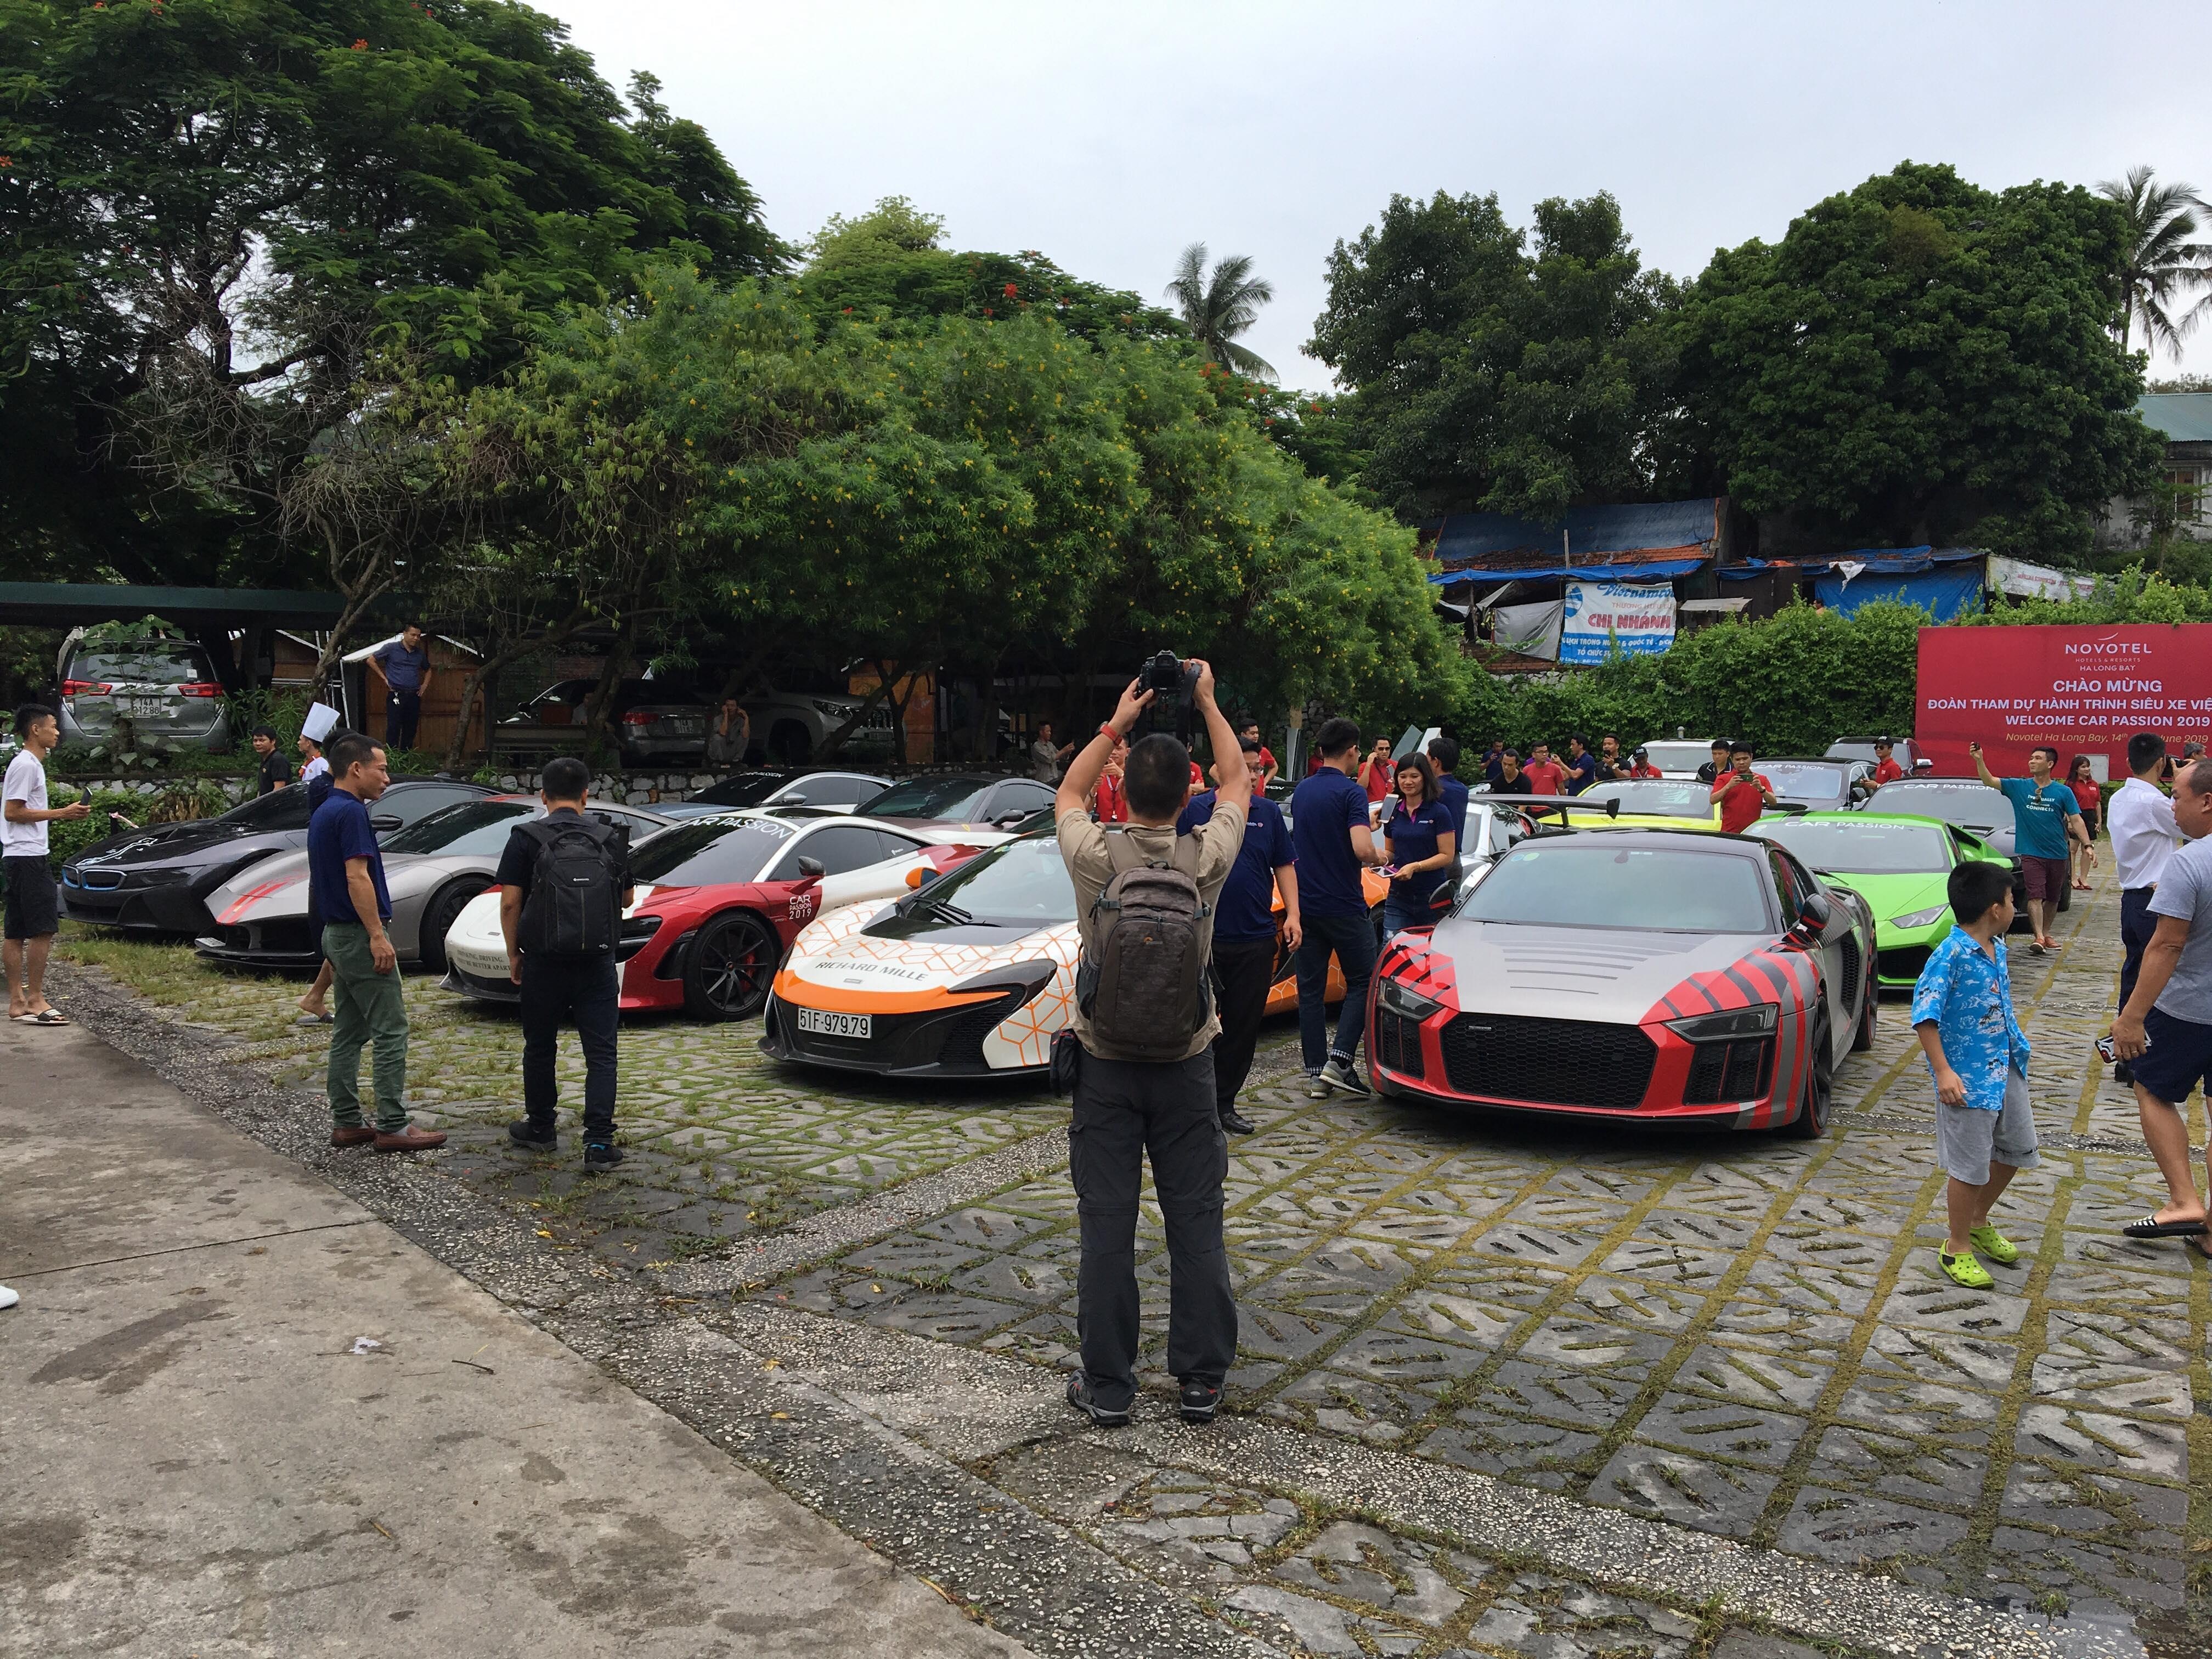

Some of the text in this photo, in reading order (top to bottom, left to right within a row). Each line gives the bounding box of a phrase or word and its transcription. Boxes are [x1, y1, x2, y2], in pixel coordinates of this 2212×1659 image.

[1588, 611, 1671, 629] CHI NHÁNH
[2065, 643, 2152, 654] NOVOTEL
[2053, 677, 2162, 692] CHÀO MỪNG
[1928, 697, 1966, 709] ĐOÀN
[1970, 699, 2010, 709] THAM
[2013, 699, 2036, 712] DỰ
[2040, 697, 2079, 709] HÀNH
[2083, 697, 2126, 709] TRÌNH
[2130, 697, 2163, 710] SIÊU
[2167, 699, 2187, 710] XE
[2005, 715, 2210, 726] WELCOME CAR PASSION 2019
[2006, 733, 2042, 741] Novotel
[2045, 733, 2059, 741] Ha
[2062, 733, 2086, 743] Long
[2088, 733, 2108, 744] Bay,
[2112, 732, 2128, 741] 14th
[2183, 735, 2209, 743] 2019
[1642, 782, 1708, 791] PASSION
[670, 817, 793, 839] CAR PASSION
[1837, 822, 1905, 830] PASSION
[789, 894, 811, 905] CAR
[789, 902, 812, 911] PASSION
[789, 908, 811, 919] 2019
[815, 962, 928, 981] RICHARD MILLE
[800, 1010, 868, 1036] 51F-979.79
